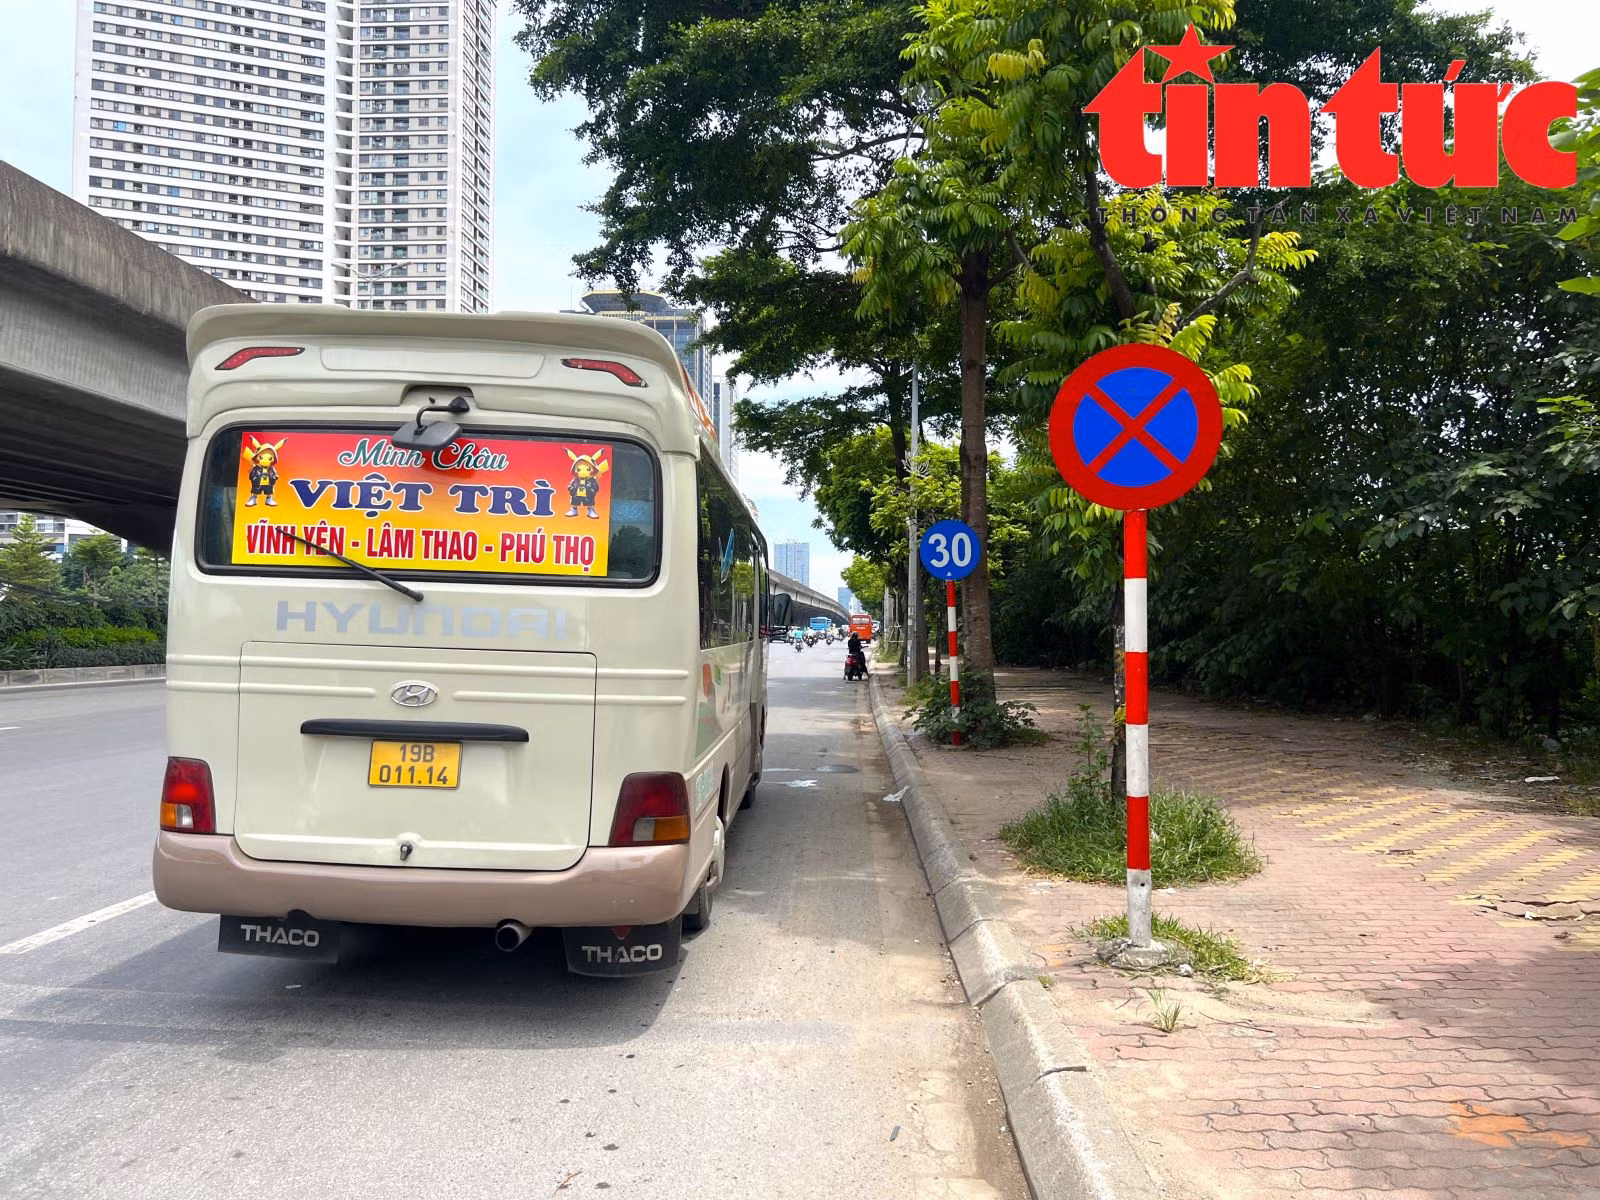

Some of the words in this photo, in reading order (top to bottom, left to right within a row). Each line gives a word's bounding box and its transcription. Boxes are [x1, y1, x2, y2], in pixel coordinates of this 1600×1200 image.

[432, 442, 509, 471] Châu
[290, 472, 434, 518] VIỆT
[448, 479, 557, 516] TRÌ
[246, 519, 296, 555] VĨNH
[303, 520, 345, 556] YÊN
[366, 522, 415, 559] LÂM
[421, 529, 478, 561] THAO
[500, 528, 546, 564] PHÚ
[552, 535, 595, 573] THỌ
[928, 532, 972, 568] 30
[400, 743, 435, 763] 19B
[379, 764, 448, 785] 011.14
[240, 923, 321, 948] THACO
[581, 943, 663, 964] THACO
